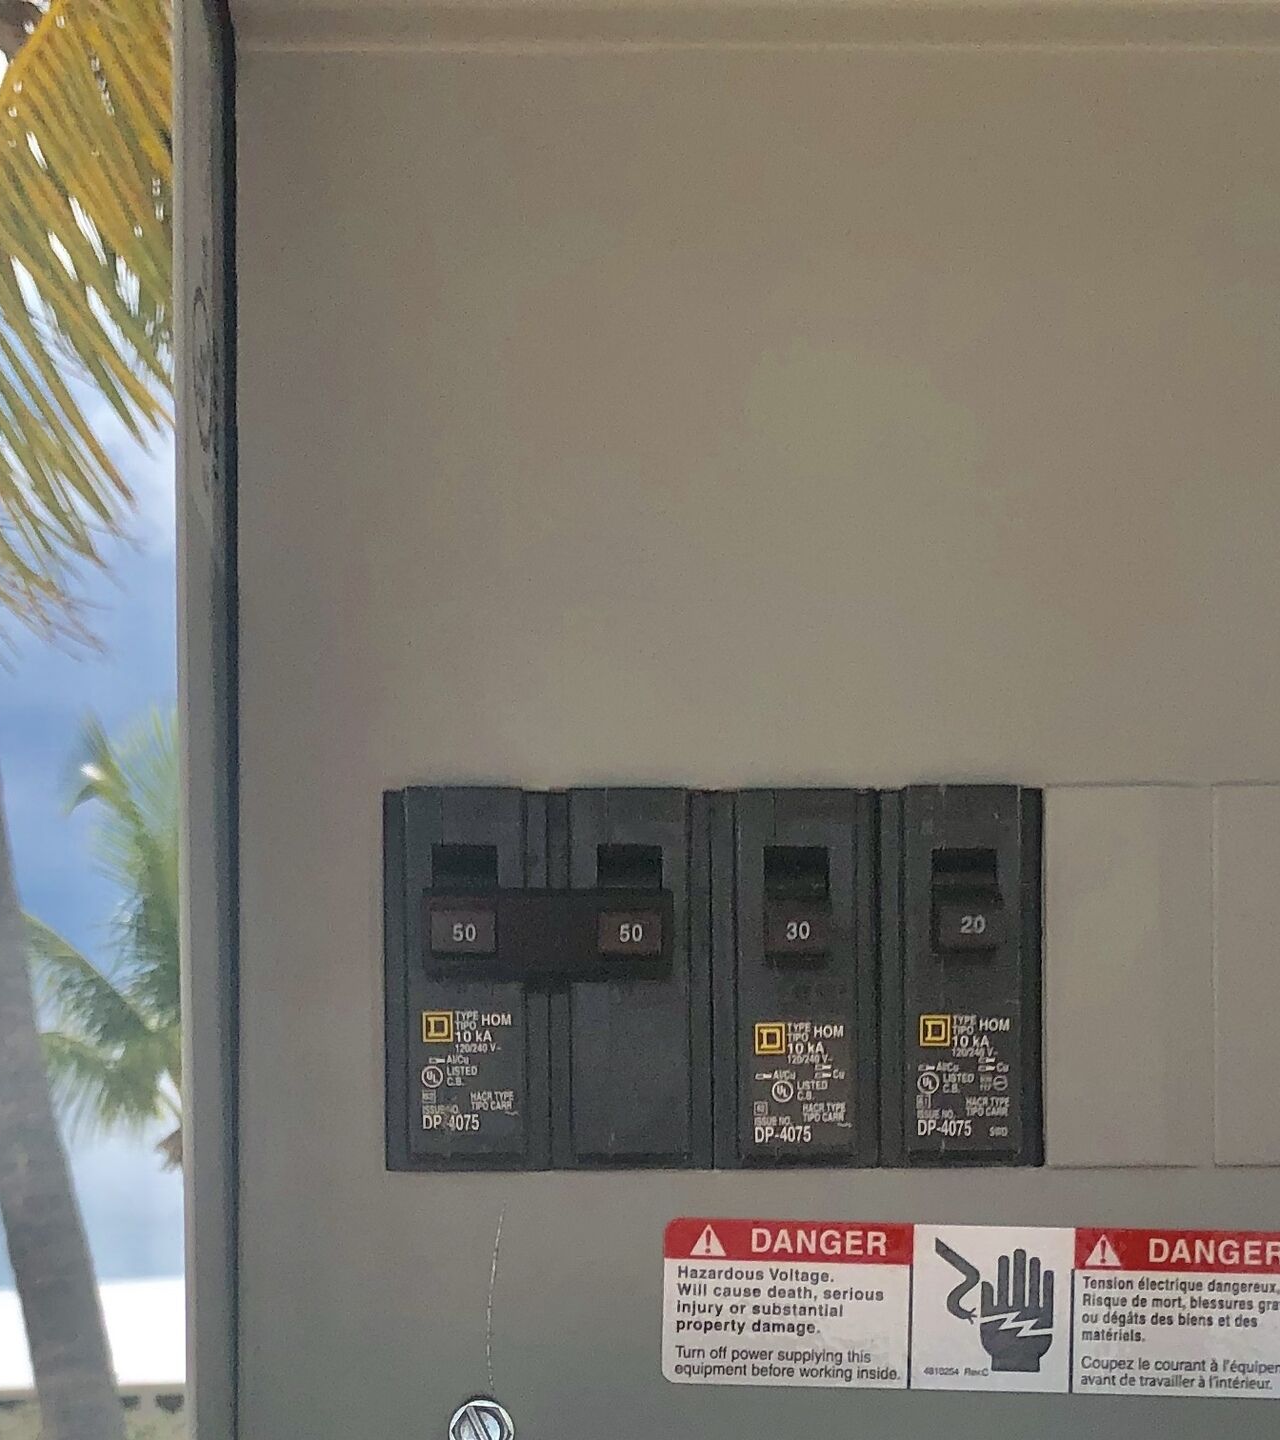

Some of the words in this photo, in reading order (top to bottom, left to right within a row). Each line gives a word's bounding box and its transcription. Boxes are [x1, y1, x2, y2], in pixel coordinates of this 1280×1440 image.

[452, 923, 476, 942] 50
[620, 923, 643, 942] 50
[786, 921, 810, 940] 30
[960, 914, 986, 934] 20
[481, 1014, 512, 1026] HOM
[980, 1019, 1010, 1031] HOM
[814, 1025, 844, 1038] HOM
[953, 1036, 968, 1047] 10
[973, 1035, 990, 1047] kA
[754, 1126, 811, 1143] DP-4075
[917, 1120, 972, 1136] DP-4075
[752, 1228, 888, 1256] DANGER
[677, 1266, 764, 1281] Hazardous
[770, 1268, 835, 1285] Voltage.
[677, 1284, 707, 1297] Will
[713, 1286, 761, 1298] cause
[768, 1286, 818, 1300] death,
[823, 1288, 884, 1301] serious
[1082, 1276, 1134, 1290] Tension
[1138, 1277, 1203, 1293] électrique
[676, 1301, 722, 1316] injury
[729, 1304, 746, 1315] or
[752, 1303, 844, 1317] substantial
[1082, 1294, 1127, 1309] Risque
[1132, 1294, 1147, 1308] de
[1151, 1297, 1186, 1310] mort,
[1190, 1297, 1254, 1310] blessures
[676, 1319, 746, 1335] property
[752, 1321, 821, 1336] damage.
[1082, 1314, 1098, 1324] ou
[1102, 1313, 1146, 1327] dégâts
[1151, 1314, 1173, 1326] des
[1178, 1314, 1213, 1326] biens
[1218, 1315, 1231, 1326] et
[1235, 1315, 1258, 1327] des
[1081, 1330, 1146, 1343] matériels.
[675, 1346, 705, 1359] Turn
[710, 1347, 727, 1360] off
[731, 1350, 773, 1363] power
[777, 1349, 843, 1365] supplying
[847, 1351, 871, 1363] this
[1081, 1356, 1134, 1372] Coupez
[1138, 1357, 1150, 1370] le
[1154, 1360, 1206, 1371] courant
[1211, 1359, 1218, 1372] à
[674, 1364, 747, 1378] equipment
[752, 1364, 795, 1378] before
[799, 1366, 852, 1382] working
[857, 1367, 901, 1381] inside.
[1081, 1375, 1117, 1386] avant
[1120, 1374, 1136, 1386] de
[1140, 1375, 1195, 1388] travailler
[1198, 1374, 1206, 1388] à
[1209, 1375, 1273, 1390] l'intérieur.
